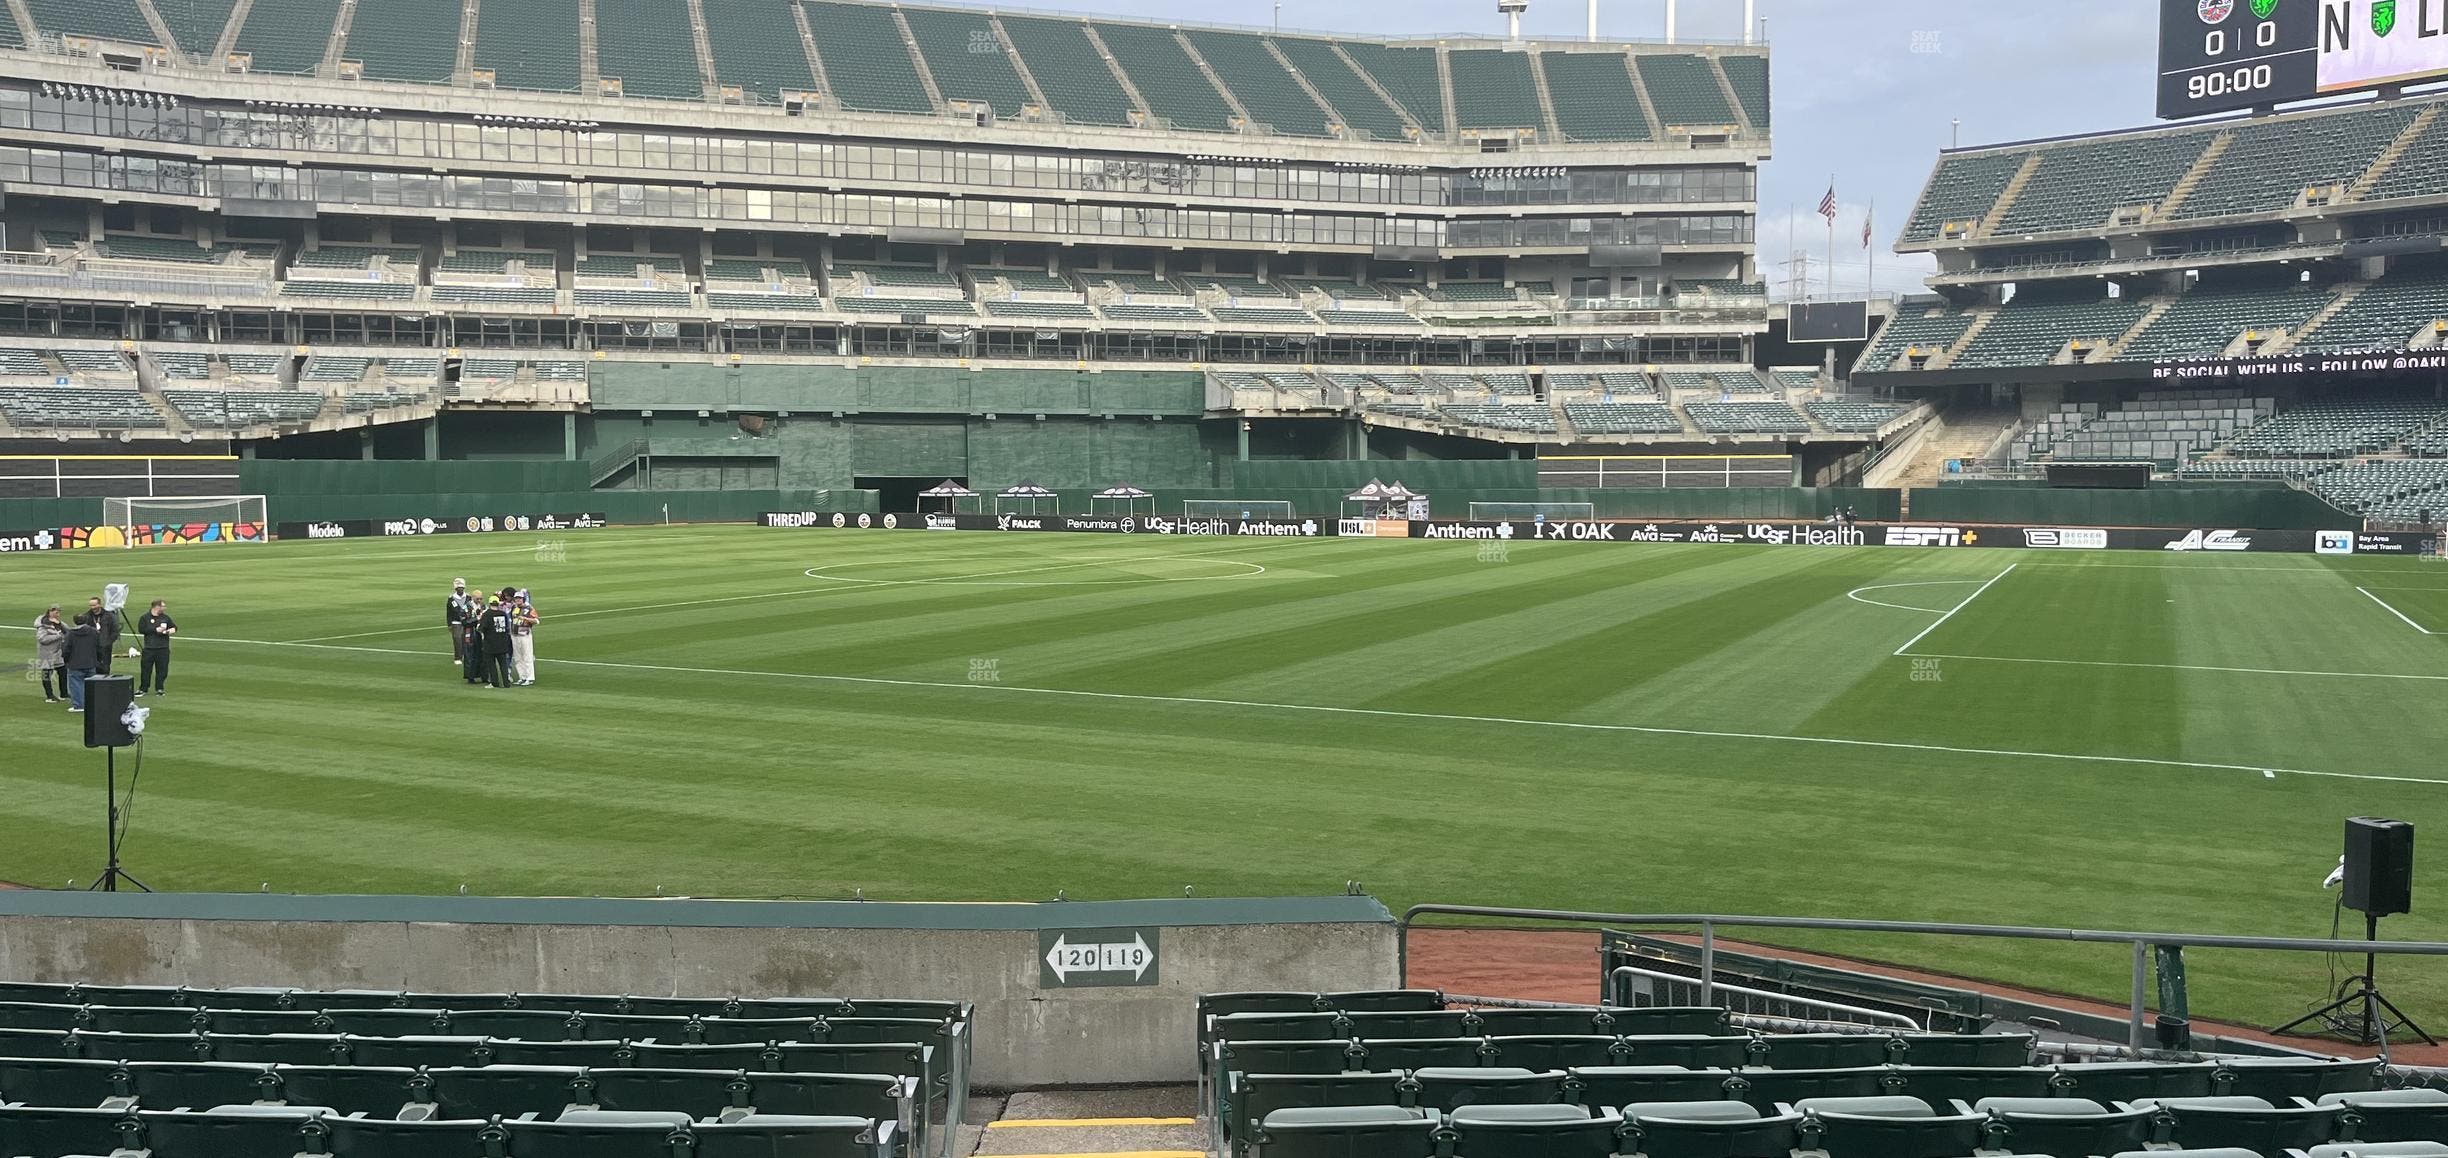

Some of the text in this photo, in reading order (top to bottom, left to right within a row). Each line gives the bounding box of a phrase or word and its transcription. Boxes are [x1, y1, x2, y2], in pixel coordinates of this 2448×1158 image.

[2205, 21, 2275, 56] 0 0
[2188, 64, 2271, 98] 90:00
[2237, 363, 2277, 375] WITH
[537, 519, 555, 529] Ava
[574, 518, 591, 528] Ava
[767, 512, 818, 527] THREDUP
[1011, 519, 1042, 529] FALCK
[1067, 518, 1118, 530] Penumbra
[1177, 517, 1230, 536] Health
[308, 523, 345, 538] Modelo
[1572, 522, 1615, 540] OAK
[1630, 529, 1658, 541] Ava
[1690, 530, 1719, 542] Ava
[1792, 525, 1864, 546] Health
[1058, 949, 1144, 966] 120 119
